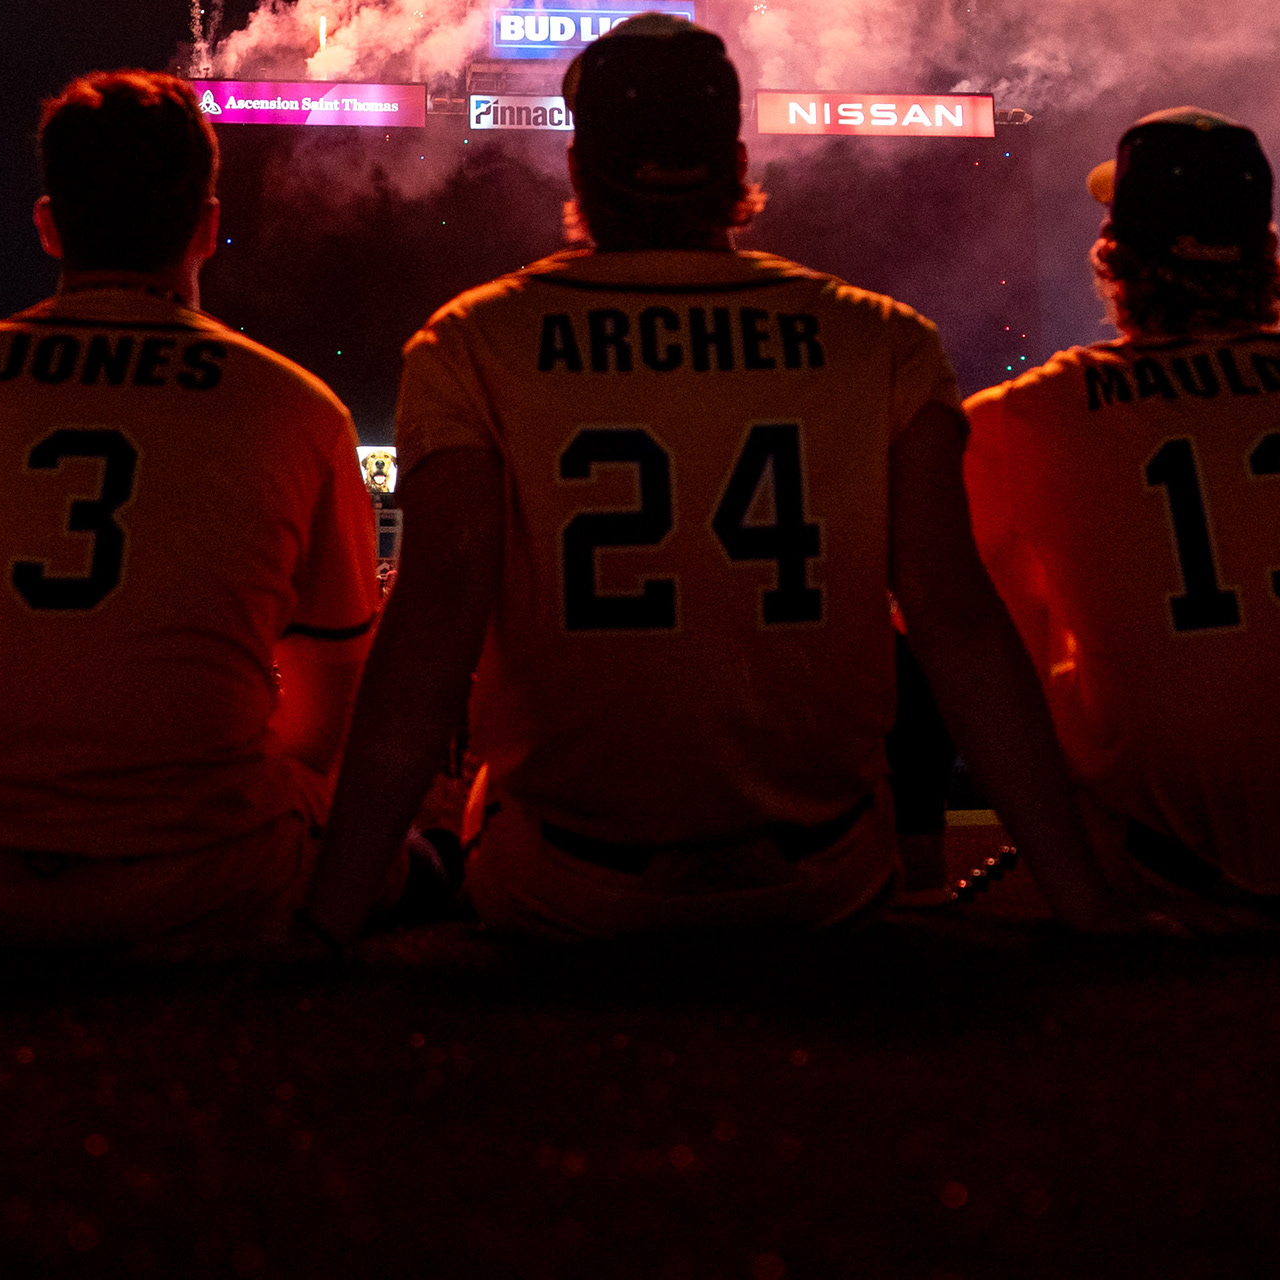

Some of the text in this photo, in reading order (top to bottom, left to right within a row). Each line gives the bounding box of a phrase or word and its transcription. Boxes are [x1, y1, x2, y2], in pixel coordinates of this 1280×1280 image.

[500, 15, 576, 42] BUD
[224, 95, 399, 112] Ascension Saint Thomas
[474, 98, 573, 127] Pinnacl
[788, 102, 963, 127] NISSAN
[537, 306, 825, 372] ARCHER
[11, 426, 142, 611] 3
[554, 418, 827, 634] 24
